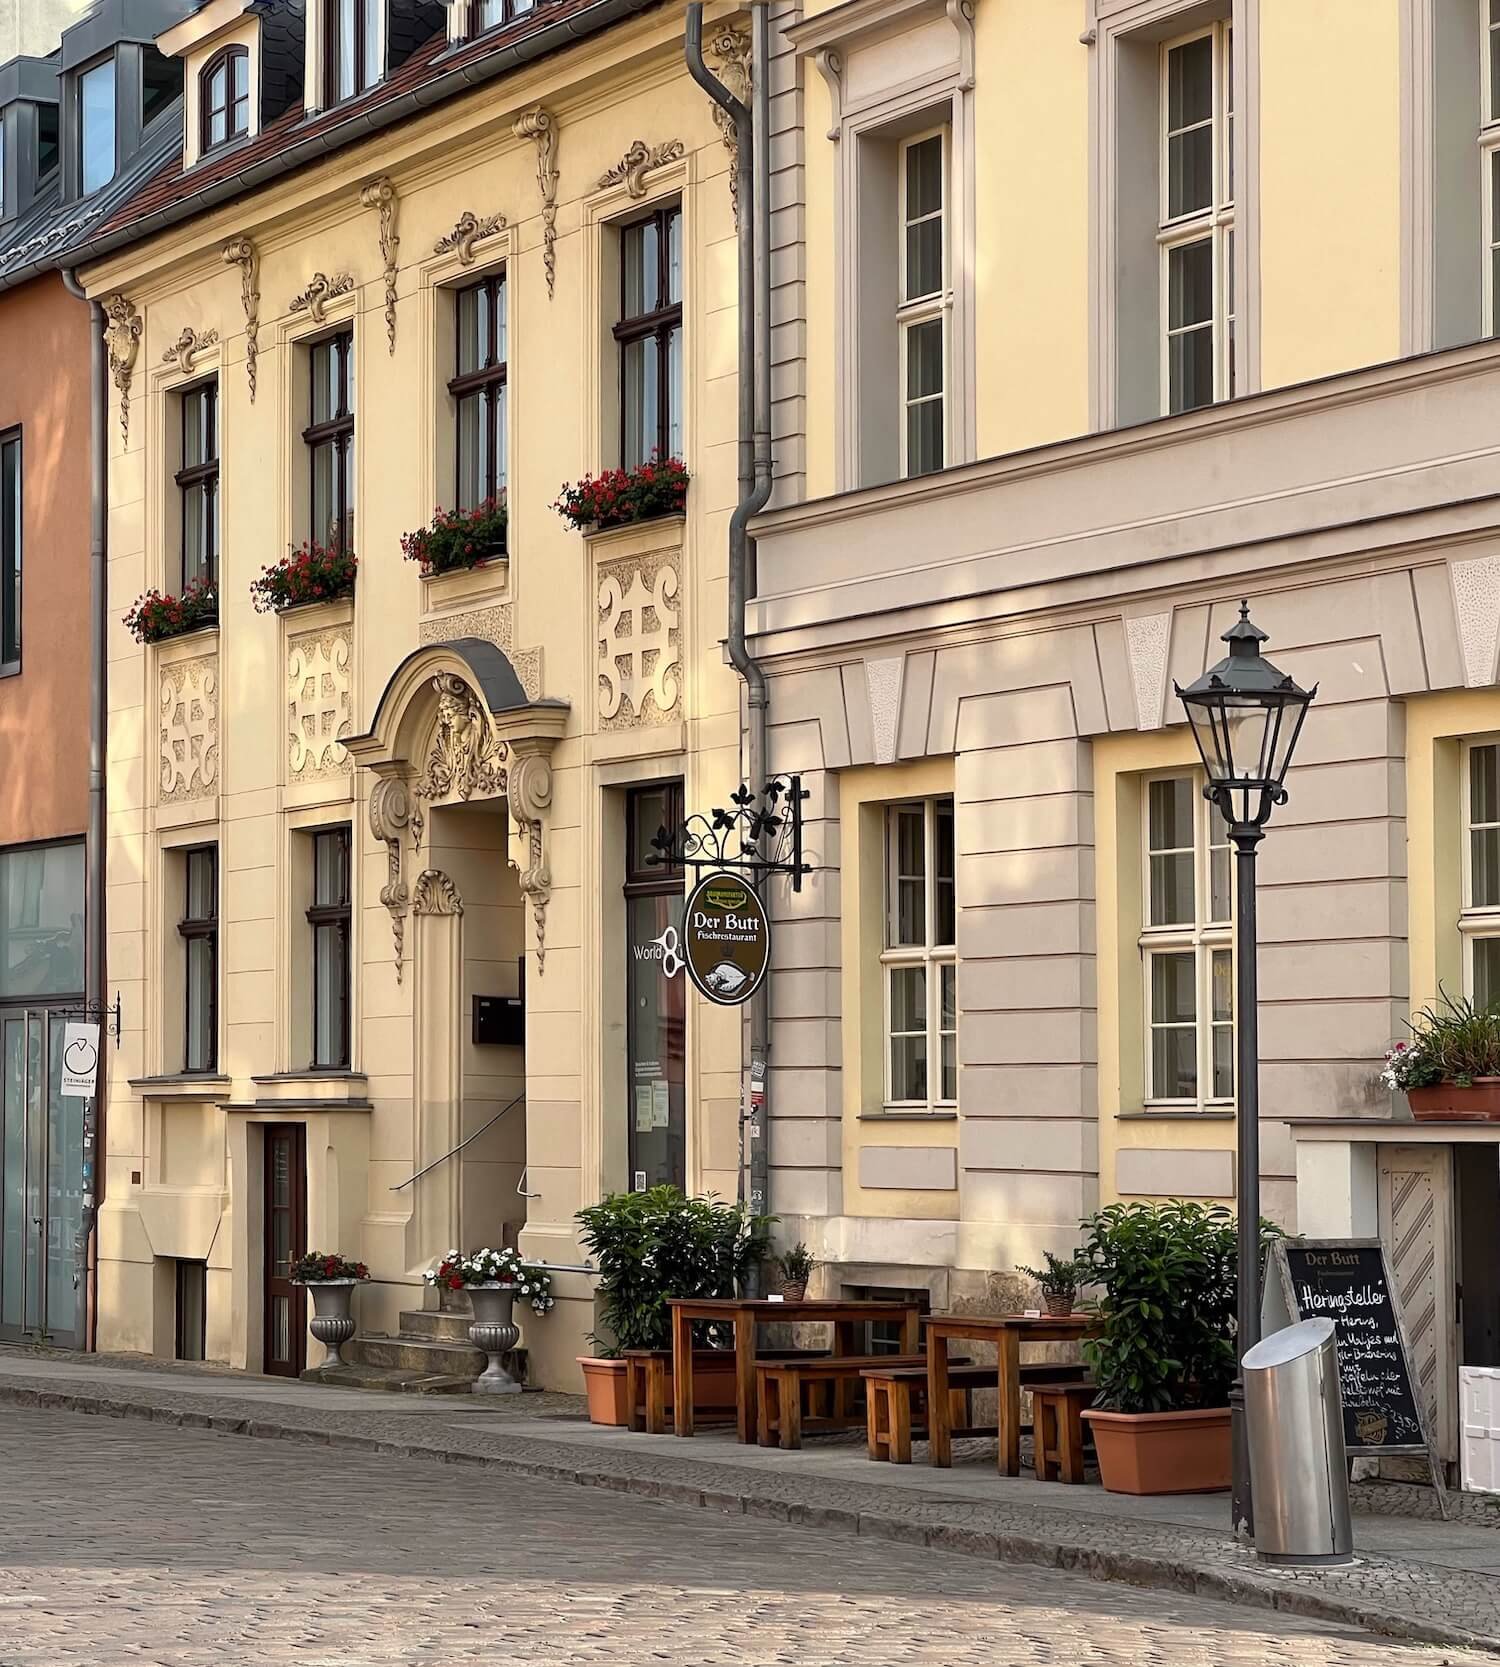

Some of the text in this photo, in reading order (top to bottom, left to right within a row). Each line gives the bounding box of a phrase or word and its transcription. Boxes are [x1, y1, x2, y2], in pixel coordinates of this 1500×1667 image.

[694, 912, 760, 930] Der Butt
[697, 930, 757, 942] Fischrestaurant
[633, 945, 662, 960] World
[1304, 1251, 1361, 1265] Der Butt
